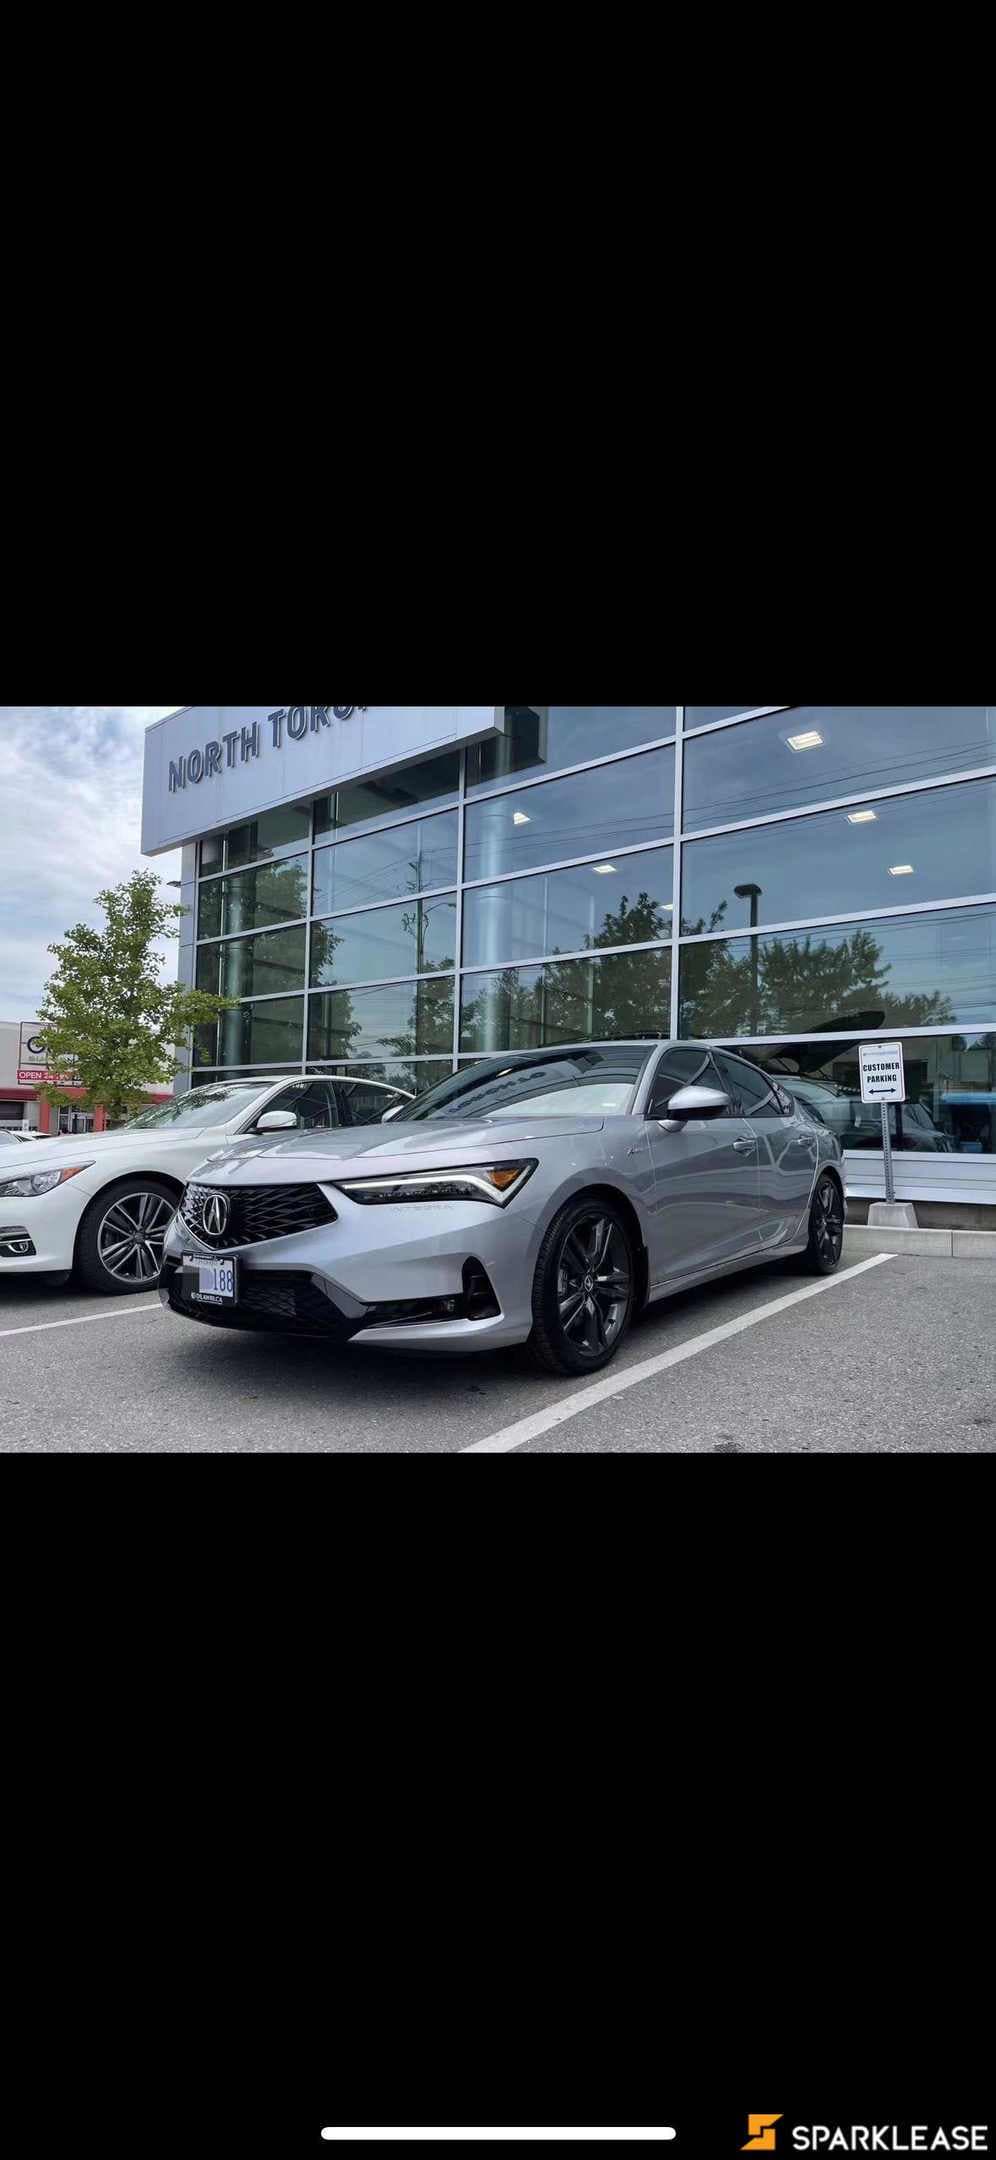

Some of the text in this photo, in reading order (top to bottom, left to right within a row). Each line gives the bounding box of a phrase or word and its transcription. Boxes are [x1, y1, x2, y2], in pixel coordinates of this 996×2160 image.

[168, 706, 367, 793] NORTH TOR
[863, 1062, 899, 1072] CUSTOMER
[19, 1071, 42, 1079] OPEN
[867, 1074, 897, 1083] PARKING
[213, 1268, 233, 1292] 188
